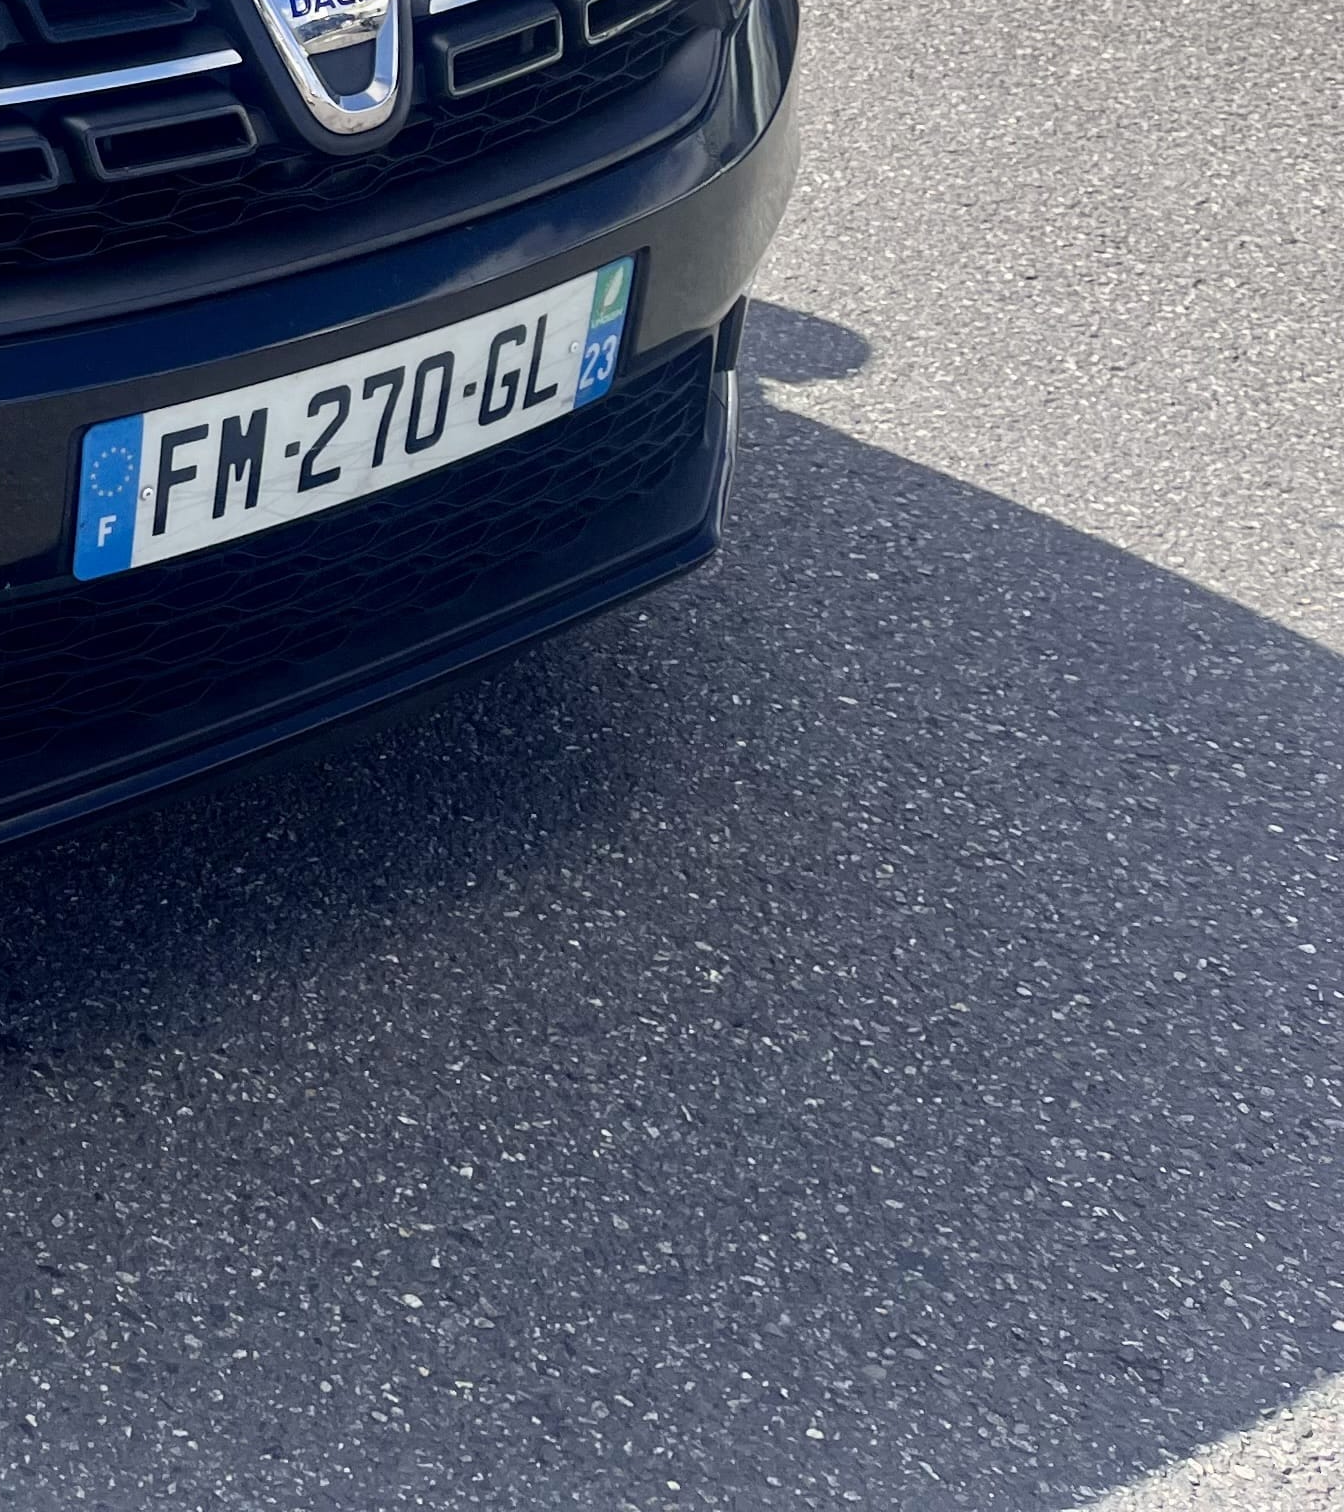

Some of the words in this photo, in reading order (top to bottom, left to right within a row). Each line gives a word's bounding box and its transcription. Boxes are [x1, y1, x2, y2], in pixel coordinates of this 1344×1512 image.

[579, 334, 618, 390] 23
[151, 314, 559, 536] FM-270-GL
[97, 515, 117, 548] F
